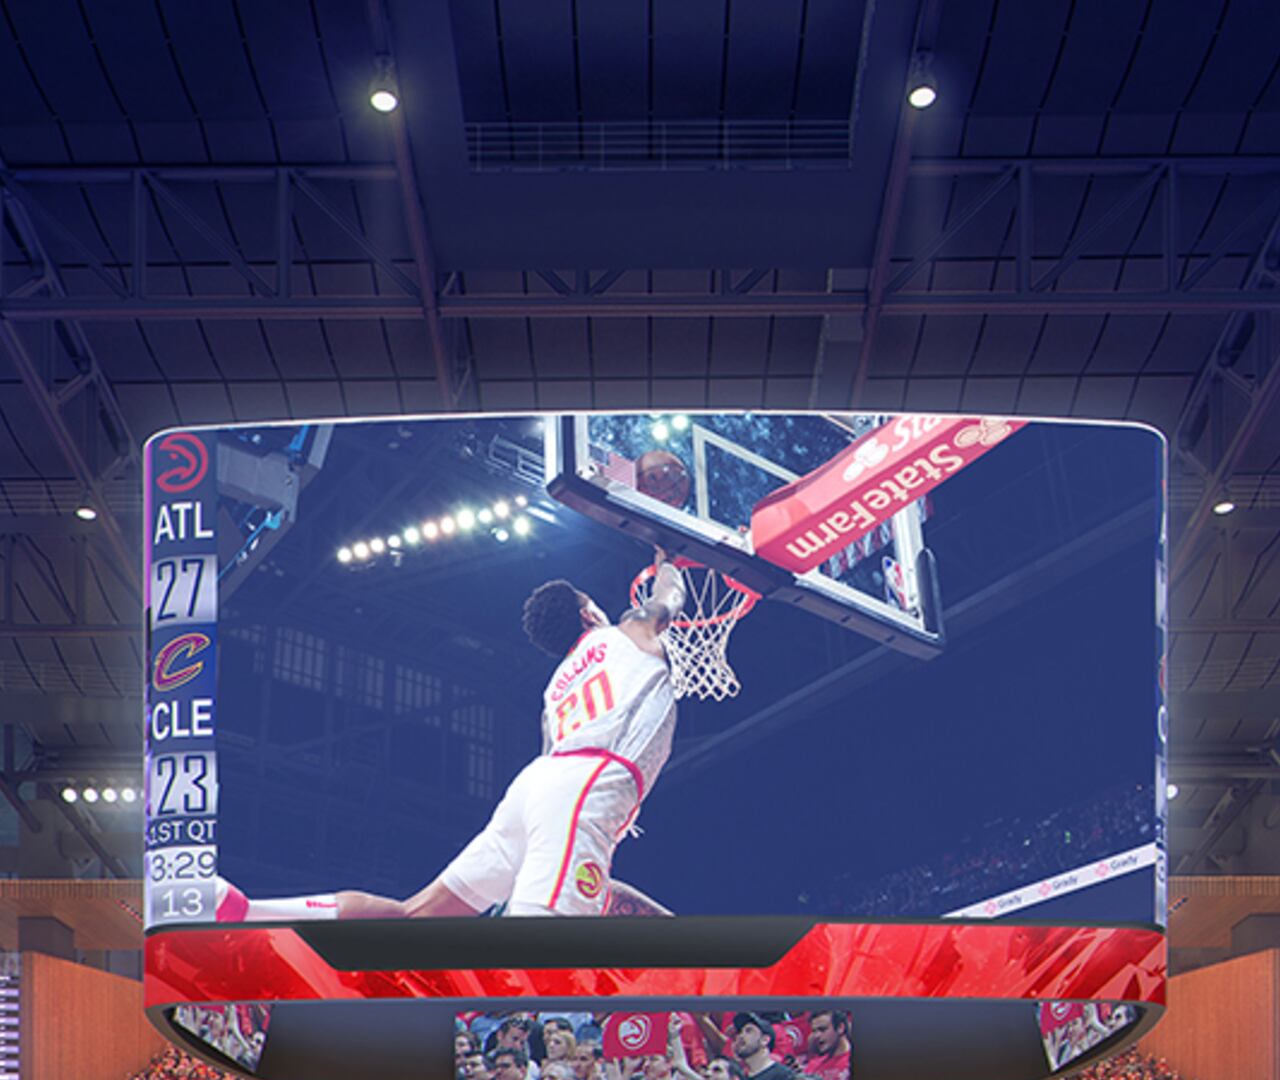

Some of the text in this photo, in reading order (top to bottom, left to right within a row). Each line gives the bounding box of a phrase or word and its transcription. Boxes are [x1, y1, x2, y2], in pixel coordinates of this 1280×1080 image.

[154, 501, 214, 545] ATL
[157, 558, 205, 622] 27
[550, 642, 607, 702] COLLINS
[151, 698, 214, 741] CLE
[157, 755, 208, 816] 23
[148, 819, 217, 846] 1ST QT
[151, 851, 217, 882] 3:29
[162, 887, 203, 917] 13
